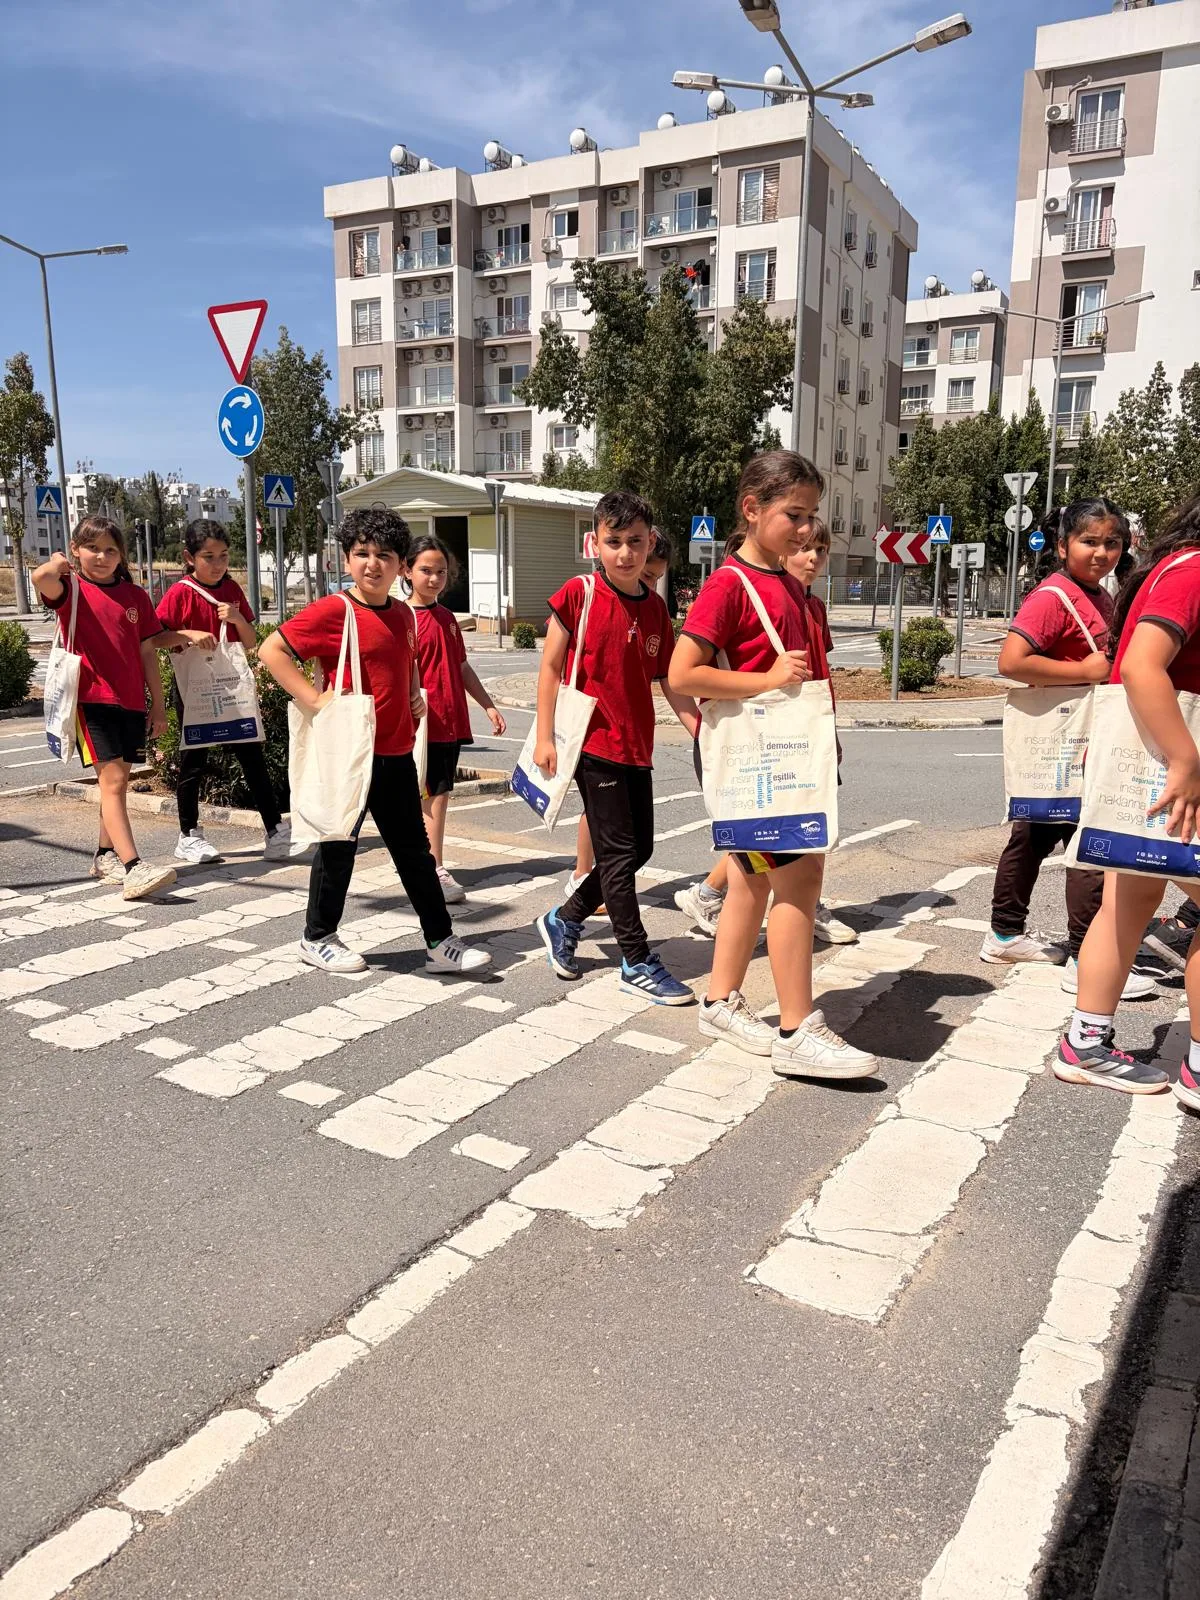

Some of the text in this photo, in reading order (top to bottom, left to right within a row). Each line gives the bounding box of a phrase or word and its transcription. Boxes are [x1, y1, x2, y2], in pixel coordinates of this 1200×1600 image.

[766, 741, 809, 750] demokrasi
[1117, 761, 1156, 778] onuru
[772, 772, 797, 783] eşitlik
